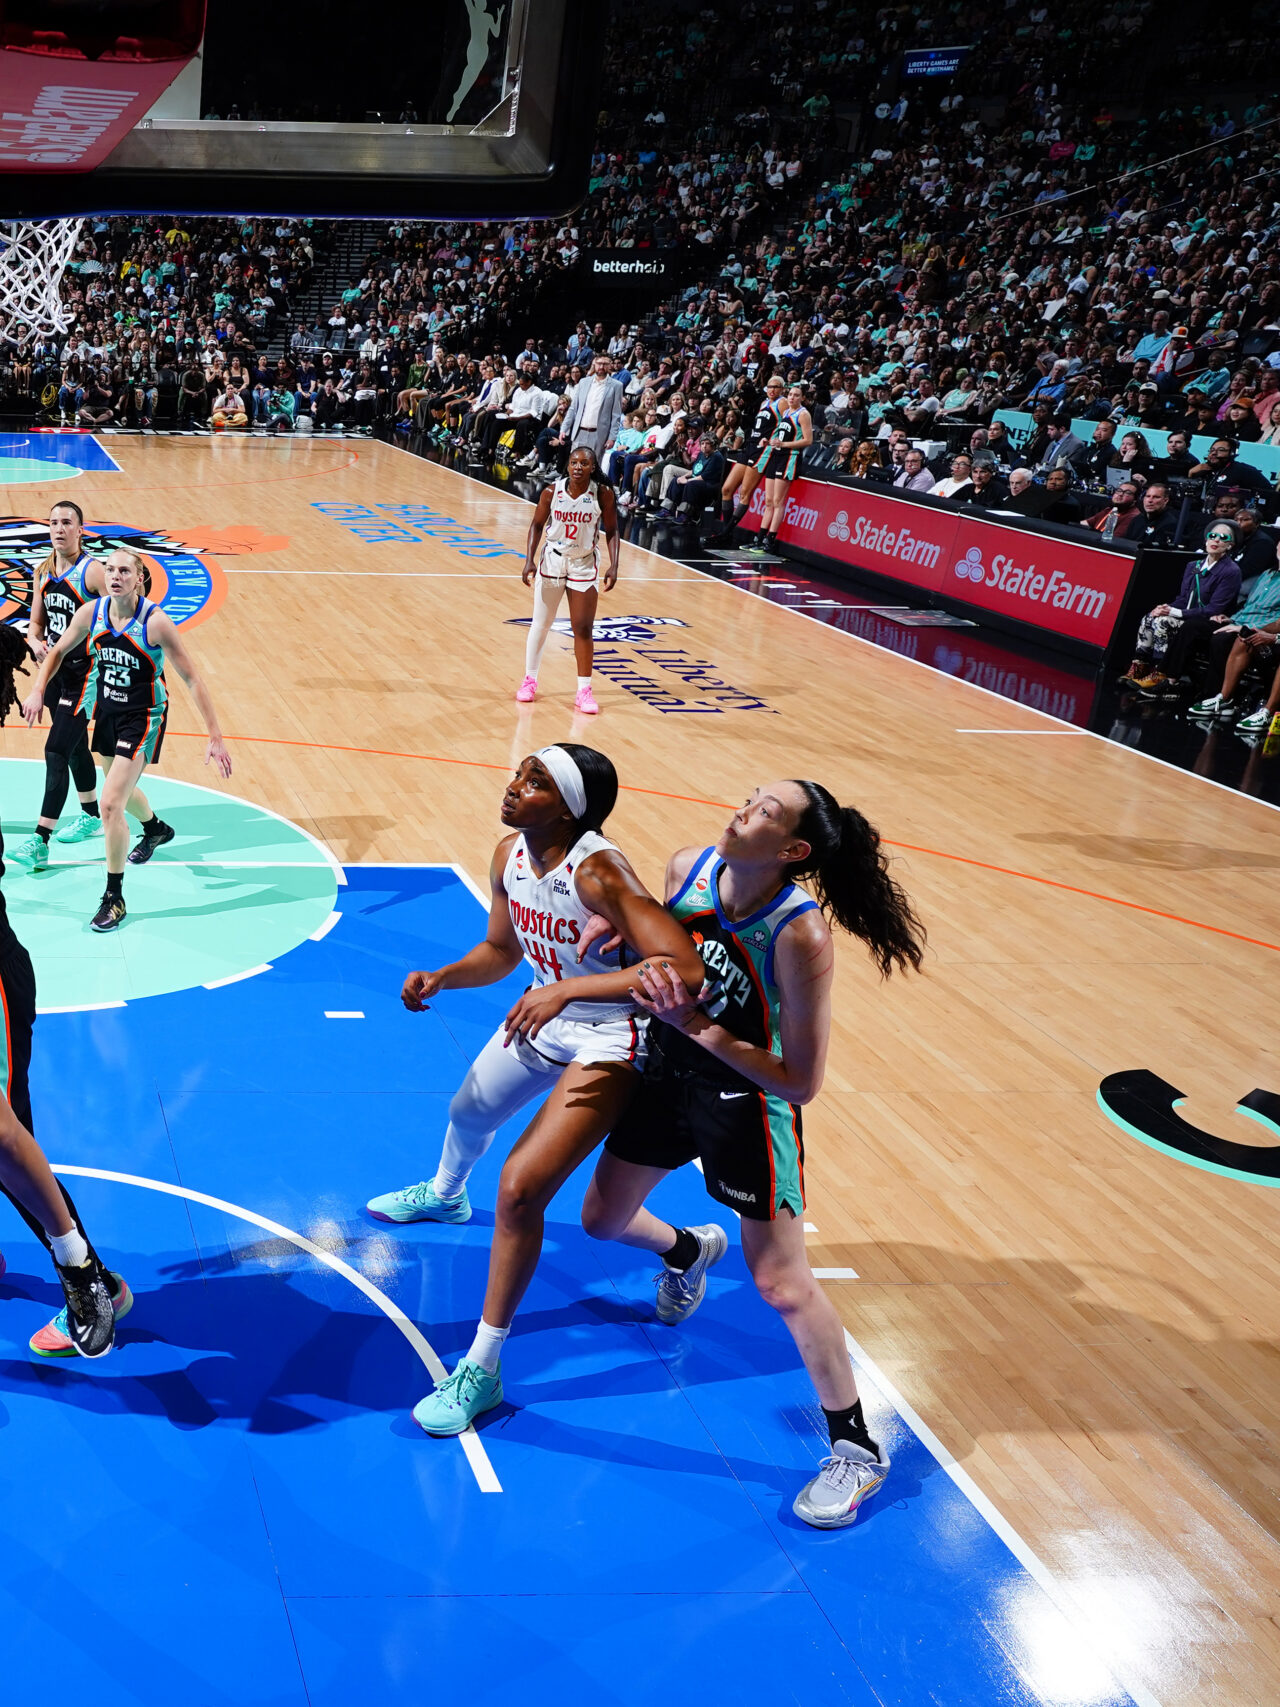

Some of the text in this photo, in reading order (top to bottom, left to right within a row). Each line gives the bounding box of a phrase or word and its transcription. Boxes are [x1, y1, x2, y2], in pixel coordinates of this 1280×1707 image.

[310, 502, 423, 543] CENTER
[374, 503, 528, 558] BARCLAYS
[565, 524, 579, 540] 12
[47, 611, 68, 636] 20
[103, 664, 131, 687] 23
[630, 648, 782, 715] Liberty
[553, 885, 571, 897] max
[554, 878, 567, 889] CAR
[524, 936, 564, 982] 44
[725, 1186, 757, 1203] WNBA
